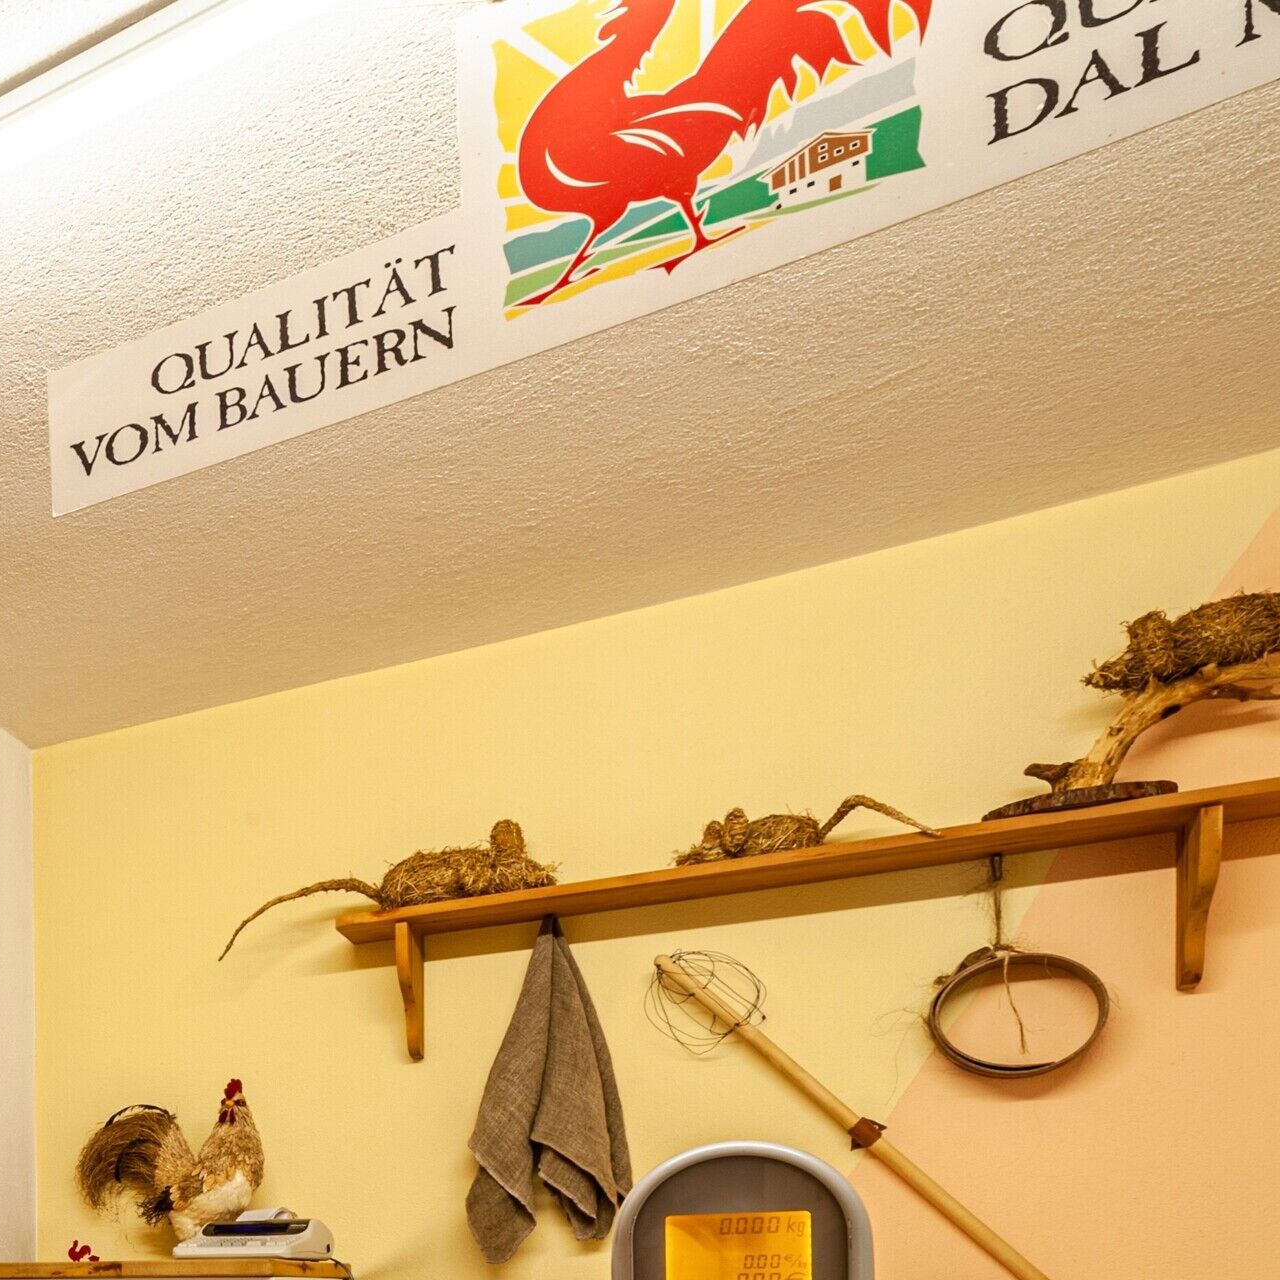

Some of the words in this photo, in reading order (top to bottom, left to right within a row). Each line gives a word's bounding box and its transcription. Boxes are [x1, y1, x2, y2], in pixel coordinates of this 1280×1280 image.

[986, 20, 1200, 146] DAL
[150, 244, 456, 395] QUALITÄT
[70, 401, 199, 477] VOM
[215, 305, 457, 432] BAUERN
[719, 1216, 781, 1236] 0.000
[786, 1216, 806, 1237] kg
[743, 1254, 781, 1270] 0.00
